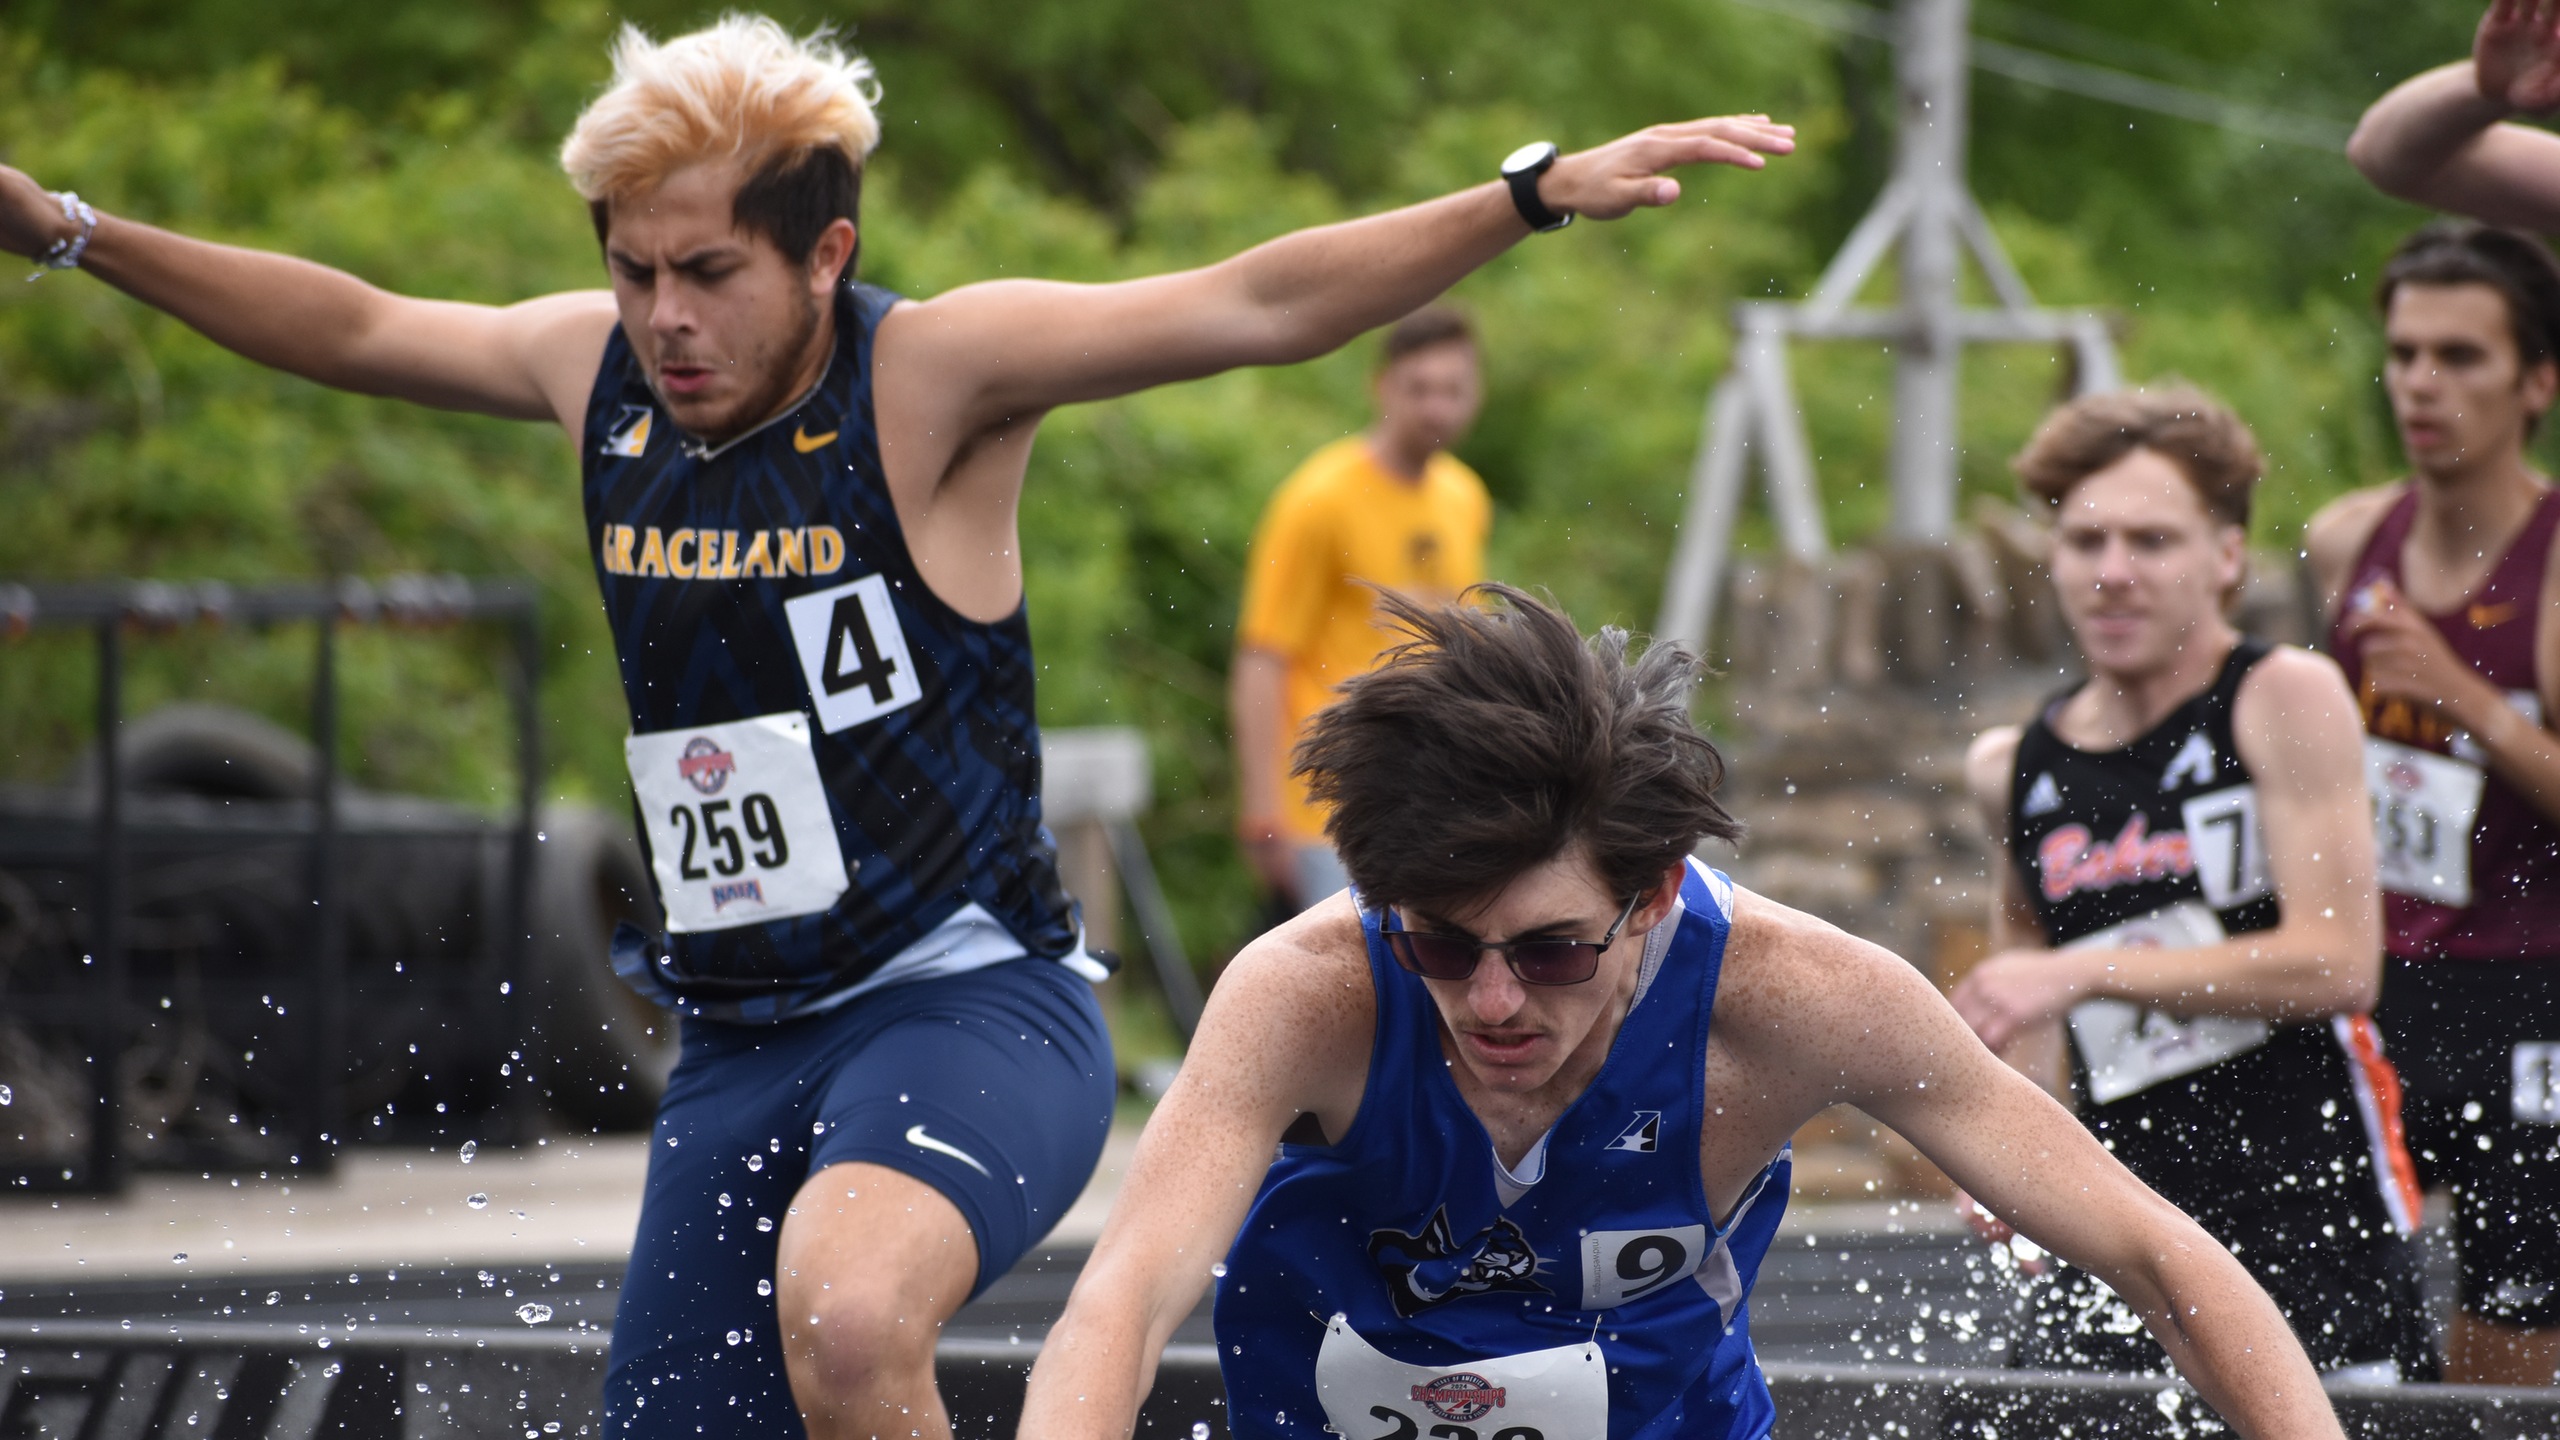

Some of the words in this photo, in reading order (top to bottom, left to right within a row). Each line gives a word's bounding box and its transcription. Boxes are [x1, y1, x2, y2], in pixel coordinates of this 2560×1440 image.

[603, 524, 845, 580] GRACELAND
[822, 593, 897, 707] 4
[670, 792, 789, 882] 259
[2204, 811, 2243, 893] 7
[1616, 1235, 1687, 1298] 9
[1411, 1385, 1506, 1408] CHAMPIONSHIPS
[1434, 1377, 1451, 1387] HEART
[1461, 1375, 1485, 1387] AMERICA
